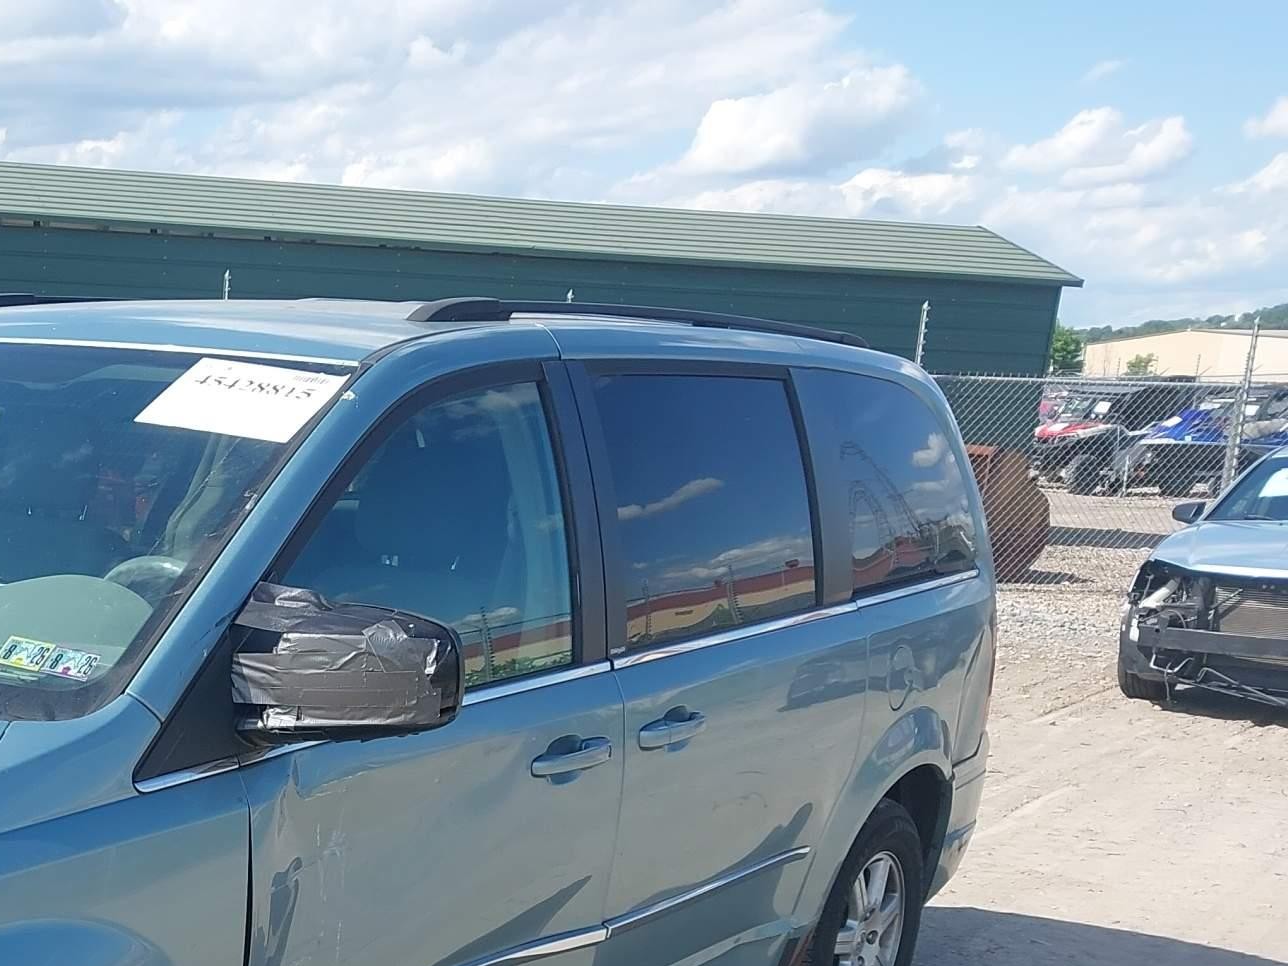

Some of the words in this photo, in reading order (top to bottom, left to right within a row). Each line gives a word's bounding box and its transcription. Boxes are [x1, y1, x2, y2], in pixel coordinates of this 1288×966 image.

[194, 375, 317, 399] 45428815
[2, 644, 17, 660] 8
[50, 654, 63, 669] 8
